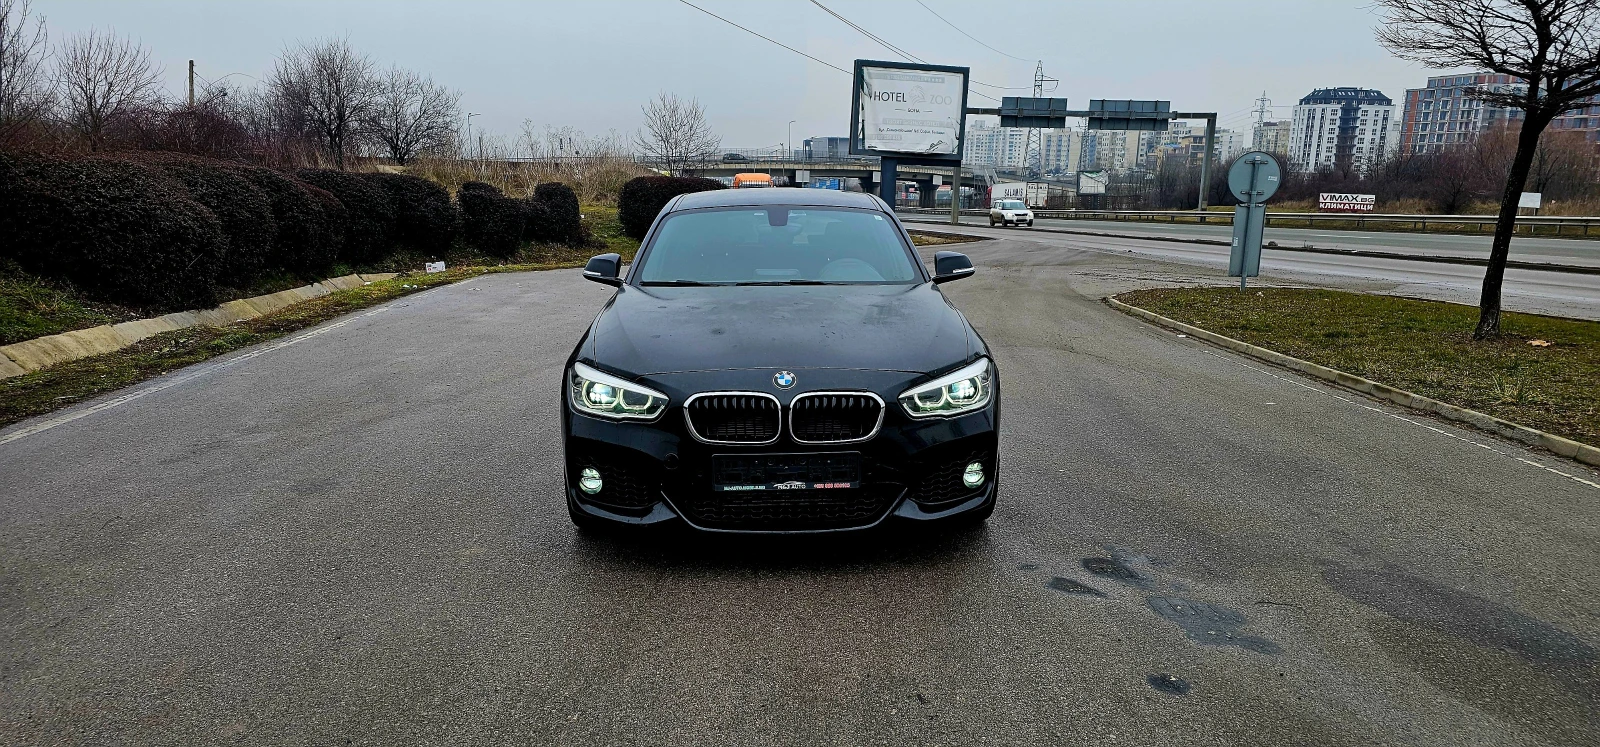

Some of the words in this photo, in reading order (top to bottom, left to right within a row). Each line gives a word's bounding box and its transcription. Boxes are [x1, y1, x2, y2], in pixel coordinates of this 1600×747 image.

[873, 91, 907, 102] HOTEL
[929, 94, 953, 106] ZOO
[1320, 202, 1374, 211] КЛИМАТИЦИ
